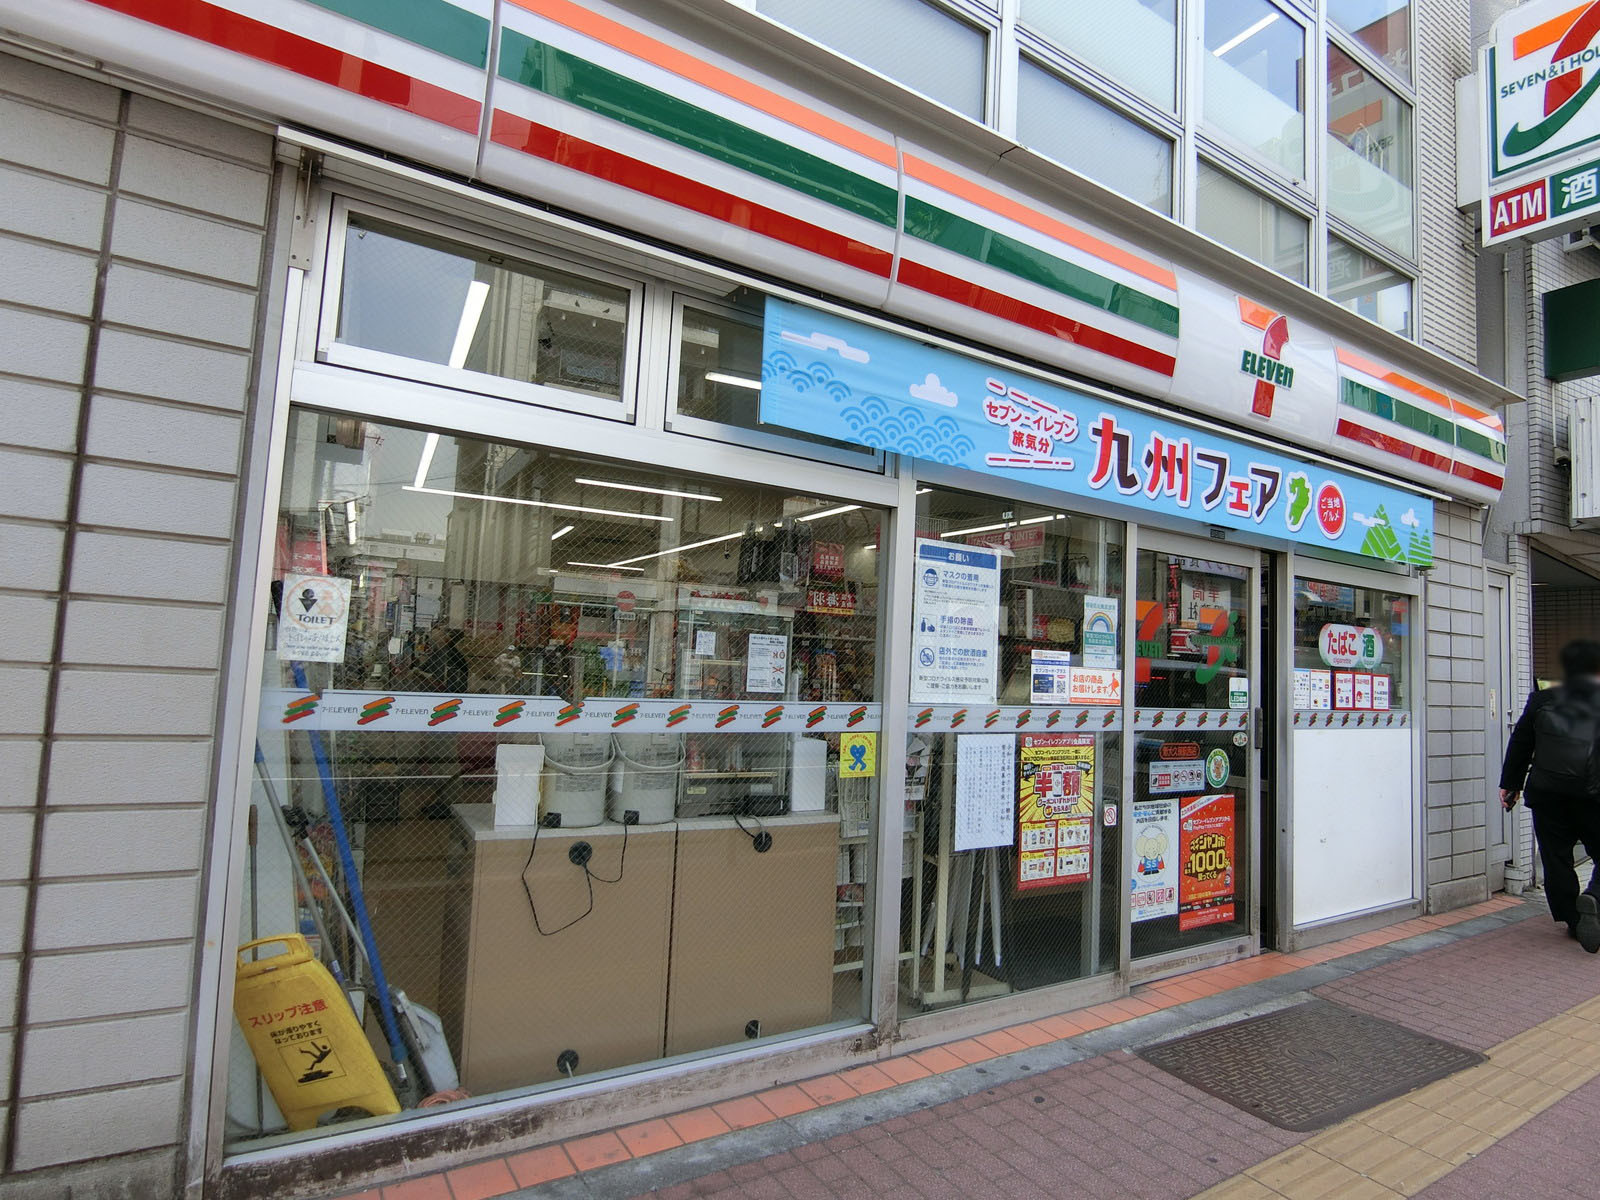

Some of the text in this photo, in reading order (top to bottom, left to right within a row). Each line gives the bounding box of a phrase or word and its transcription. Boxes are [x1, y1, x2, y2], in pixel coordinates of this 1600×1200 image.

[1561, 167, 1598, 209] 酒
[1493, 187, 1543, 230] ATM
[1012, 429, 1050, 455] 旅気分
[1091, 417, 1280, 519] 九州フェア
[1320, 495, 1341, 510] ご当地
[1322, 508, 1340, 524] グルメ
[948, 552, 970, 563] お願い
[942, 570, 980, 582] マスクの着用
[295, 613, 337, 625] TOILET
[1327, 630, 1358, 656] たばこ
[1362, 633, 1375, 658] 酒
[1072, 674, 1104, 684] お店の商品
[247, 998, 329, 1029] スリップ注意
[269, 1019, 322, 1039] 床が滑りやすく
[274, 1027, 323, 1045] なっております
